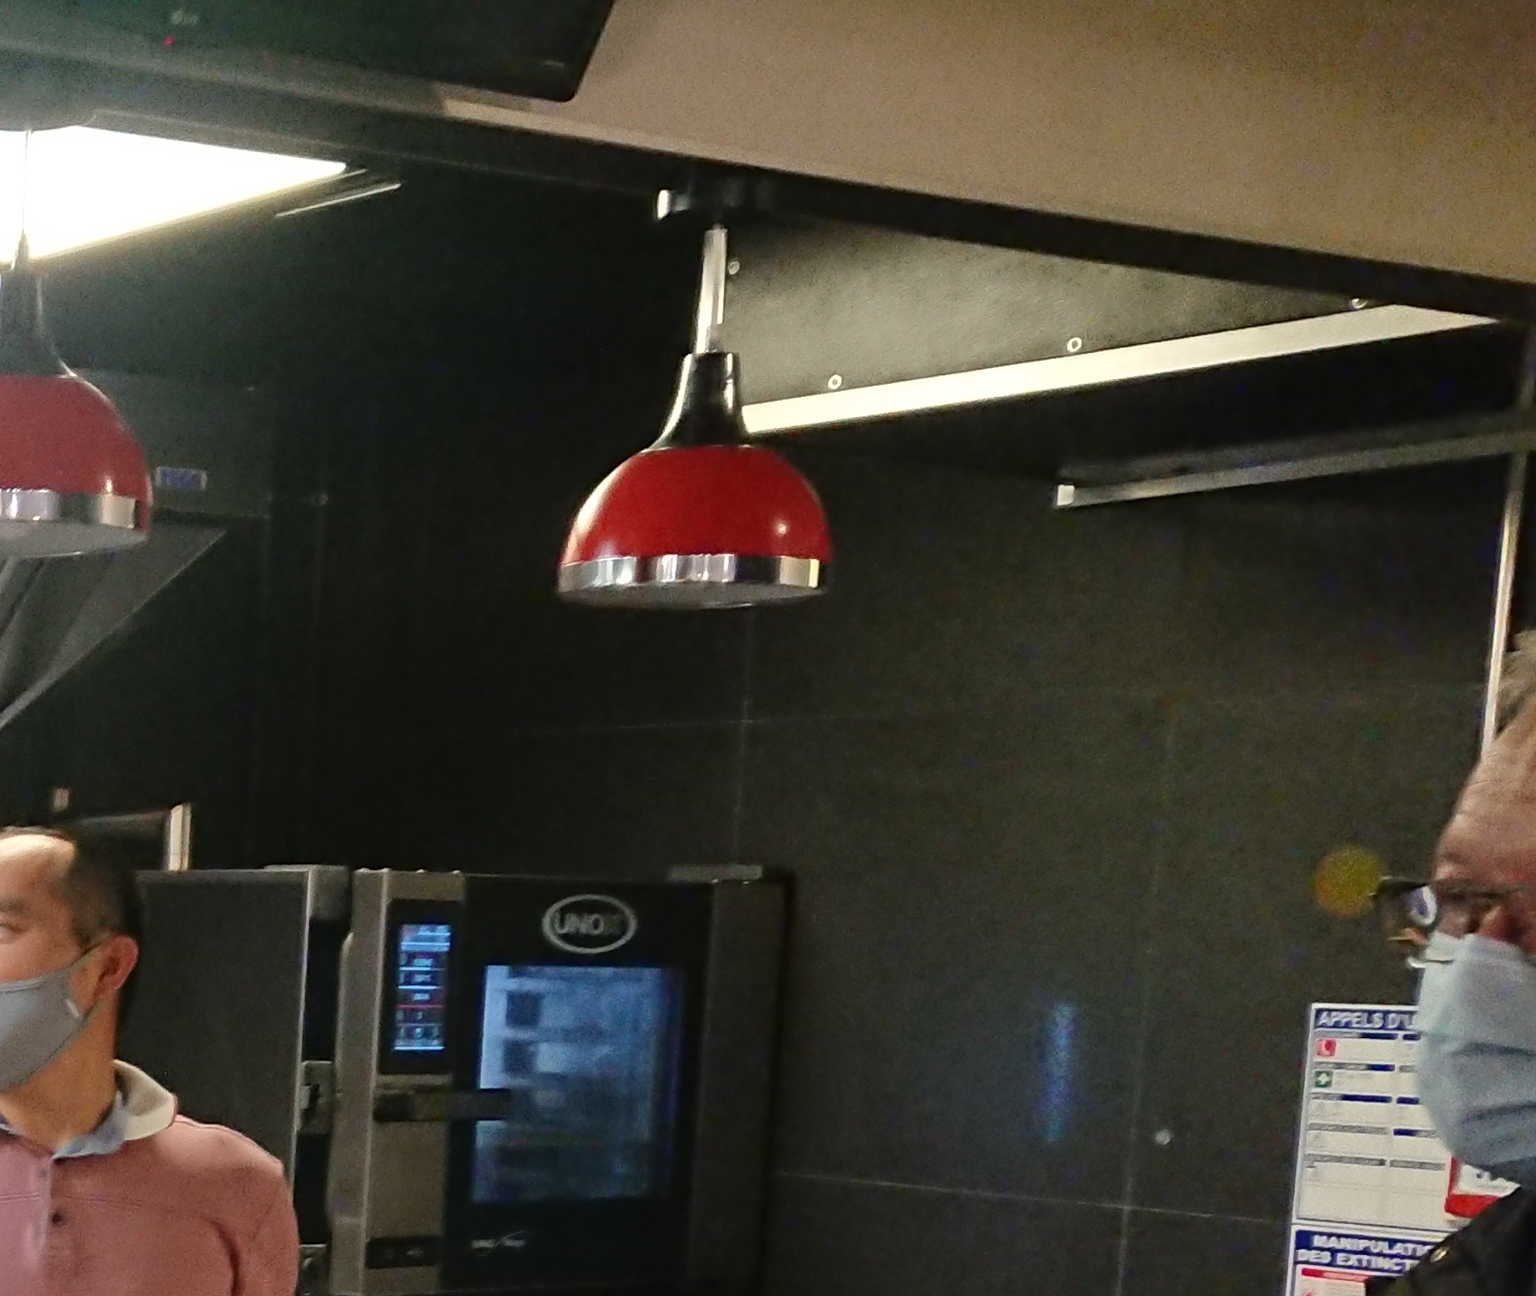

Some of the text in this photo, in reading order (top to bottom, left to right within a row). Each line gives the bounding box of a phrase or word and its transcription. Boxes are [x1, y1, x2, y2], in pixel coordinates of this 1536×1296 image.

[1317, 1010, 1420, 1031] APPELS D'U
[1296, 1249, 1418, 1273] DES EXTINCT
